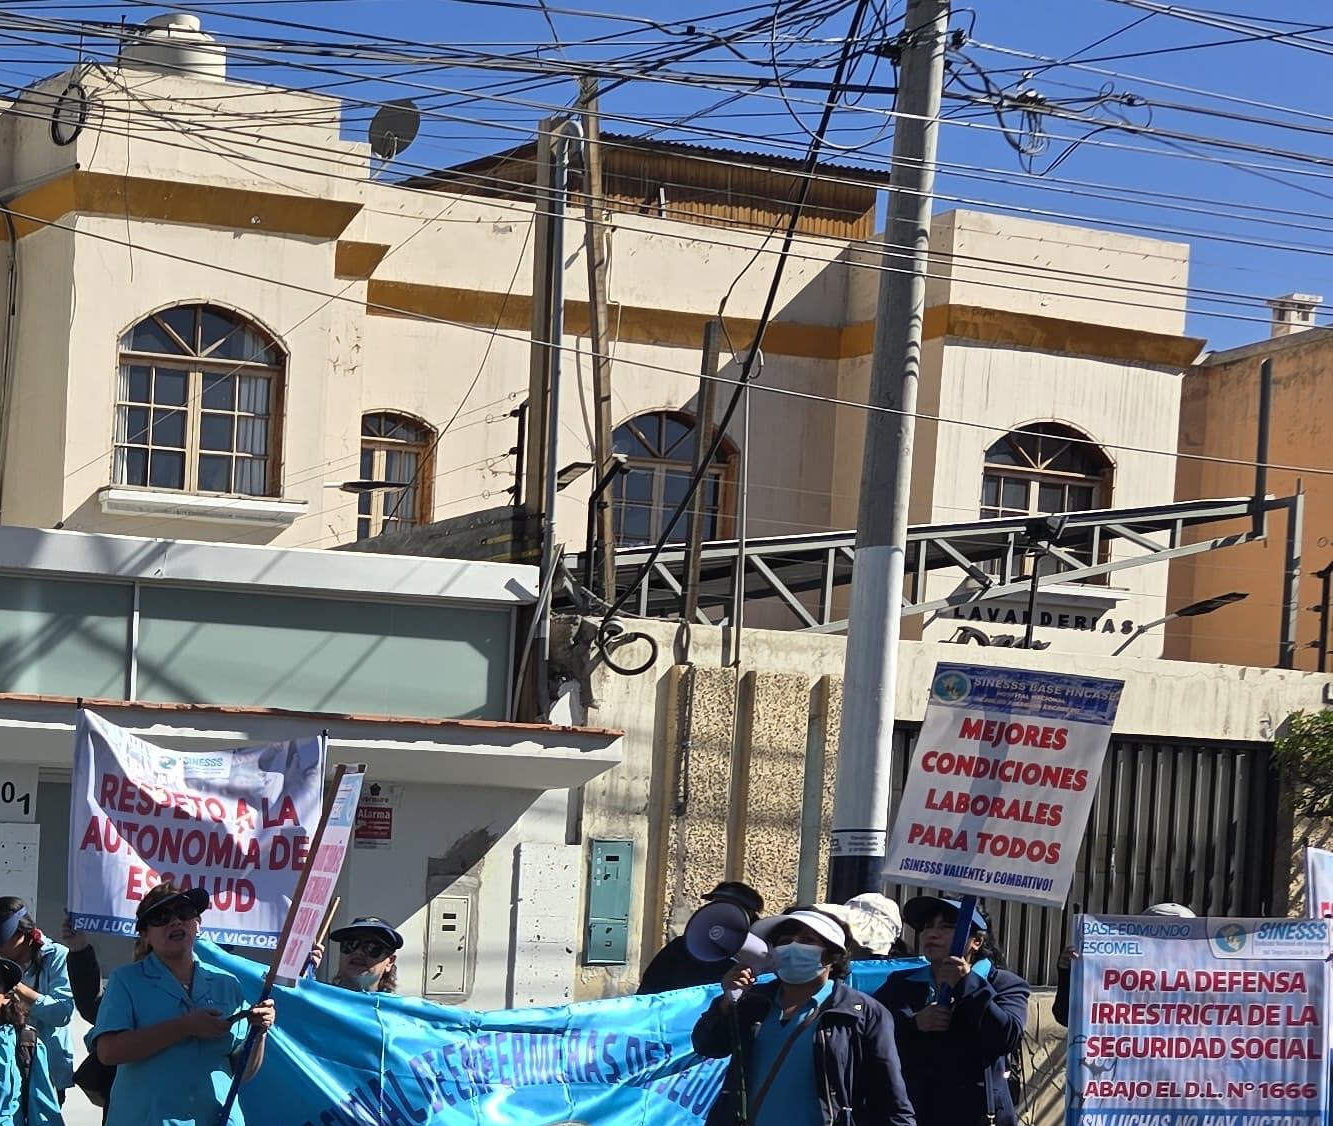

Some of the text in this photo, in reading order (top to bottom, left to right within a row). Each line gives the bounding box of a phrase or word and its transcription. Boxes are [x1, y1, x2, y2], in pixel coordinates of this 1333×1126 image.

[974, 677, 1025, 691] SINESSS
[1029, 683, 1061, 695] BASE
[959, 717, 1068, 750] MEJORES
[922, 751, 1088, 792] CONDICIONES
[101, 774, 225, 823] RESPETO
[262, 795, 300, 828] LA
[925, 788, 1063, 827] LABORALES
[358, 809, 390, 819] Alarma
[268, 835, 309, 870] DE
[908, 823, 969, 851] PARA
[976, 833, 1062, 864] TODOS
[899, 857, 1053, 892] ¡SINESSS VALIENTE y COMBATIVO!
[74, 917, 101, 931] ¡SIN
[1258, 922, 1327, 940] SINESSS
[1083, 942, 1142, 955] ESCOMEL
[1103, 969, 1306, 993] POR LA DEFENSA
[1091, 1003, 1319, 1026] IRRESTRICTA DE LA
[1087, 1036, 1321, 1060] SEGURIDAD SOCIAL
[1085, 1081, 1151, 1100] ABAJO
[1156, 1081, 1181, 1098] EL
[1185, 1081, 1222, 1099] D.L.
[1259, 1083, 1317, 1098] 1666
